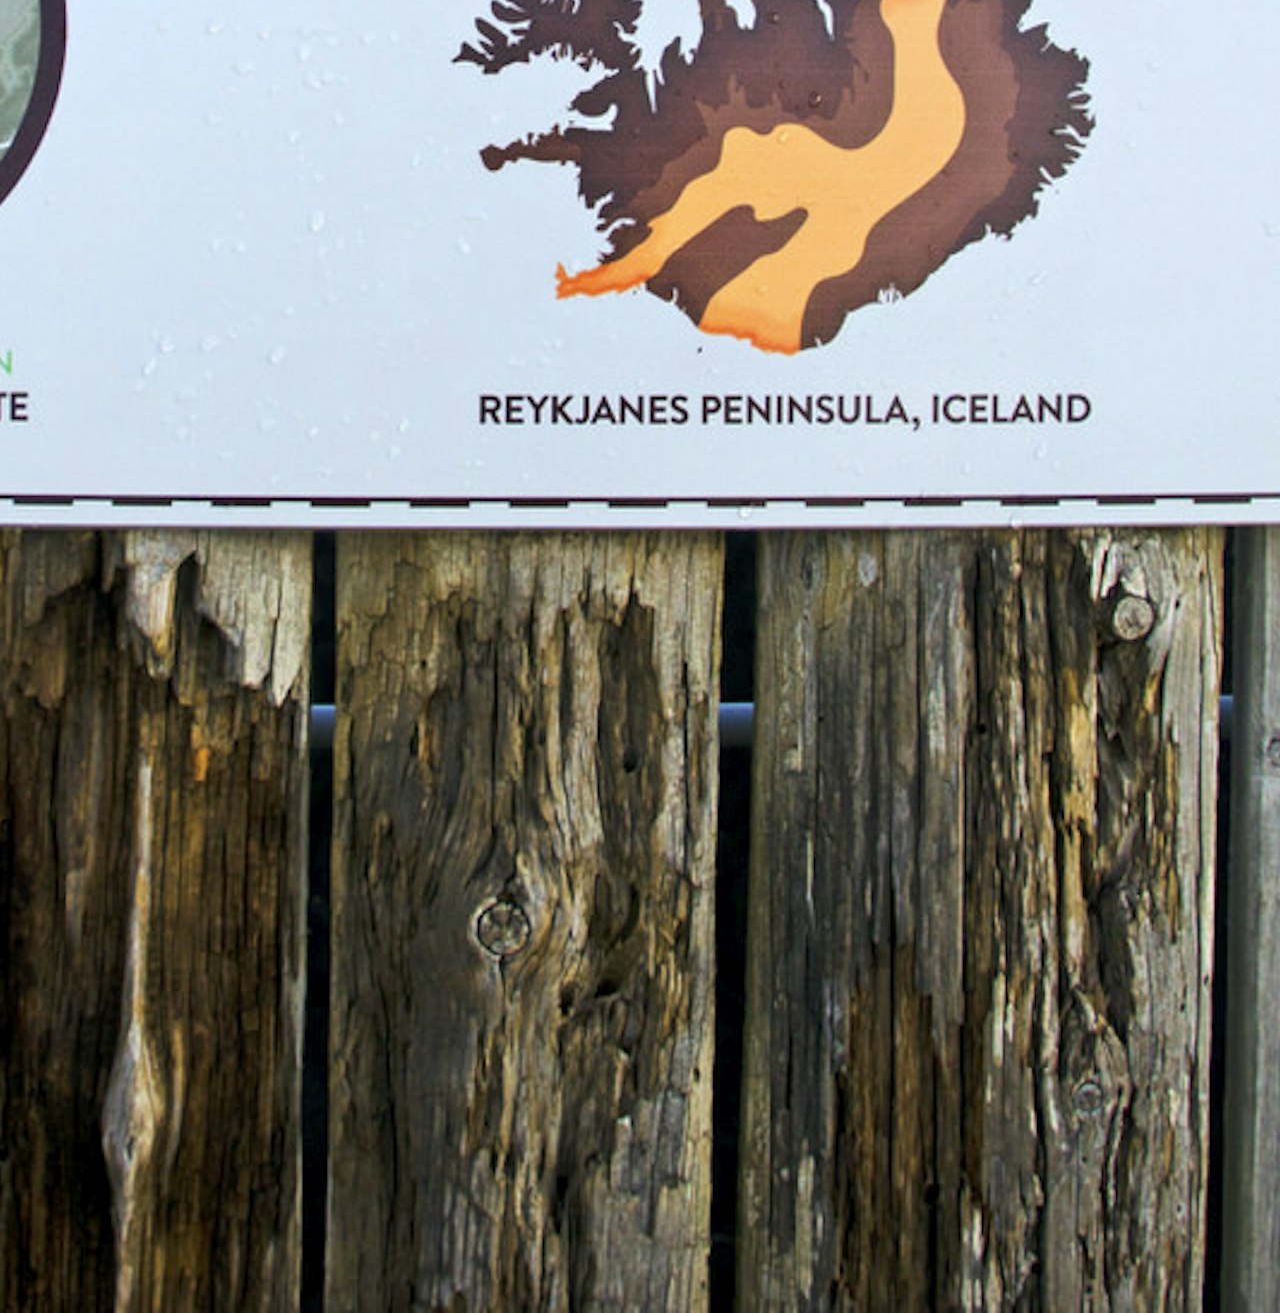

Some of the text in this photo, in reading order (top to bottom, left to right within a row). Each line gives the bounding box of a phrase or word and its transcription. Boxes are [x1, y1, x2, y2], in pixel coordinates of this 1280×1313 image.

[479, 394, 1091, 431] REYKJANES PENINSULA, ICELAND
